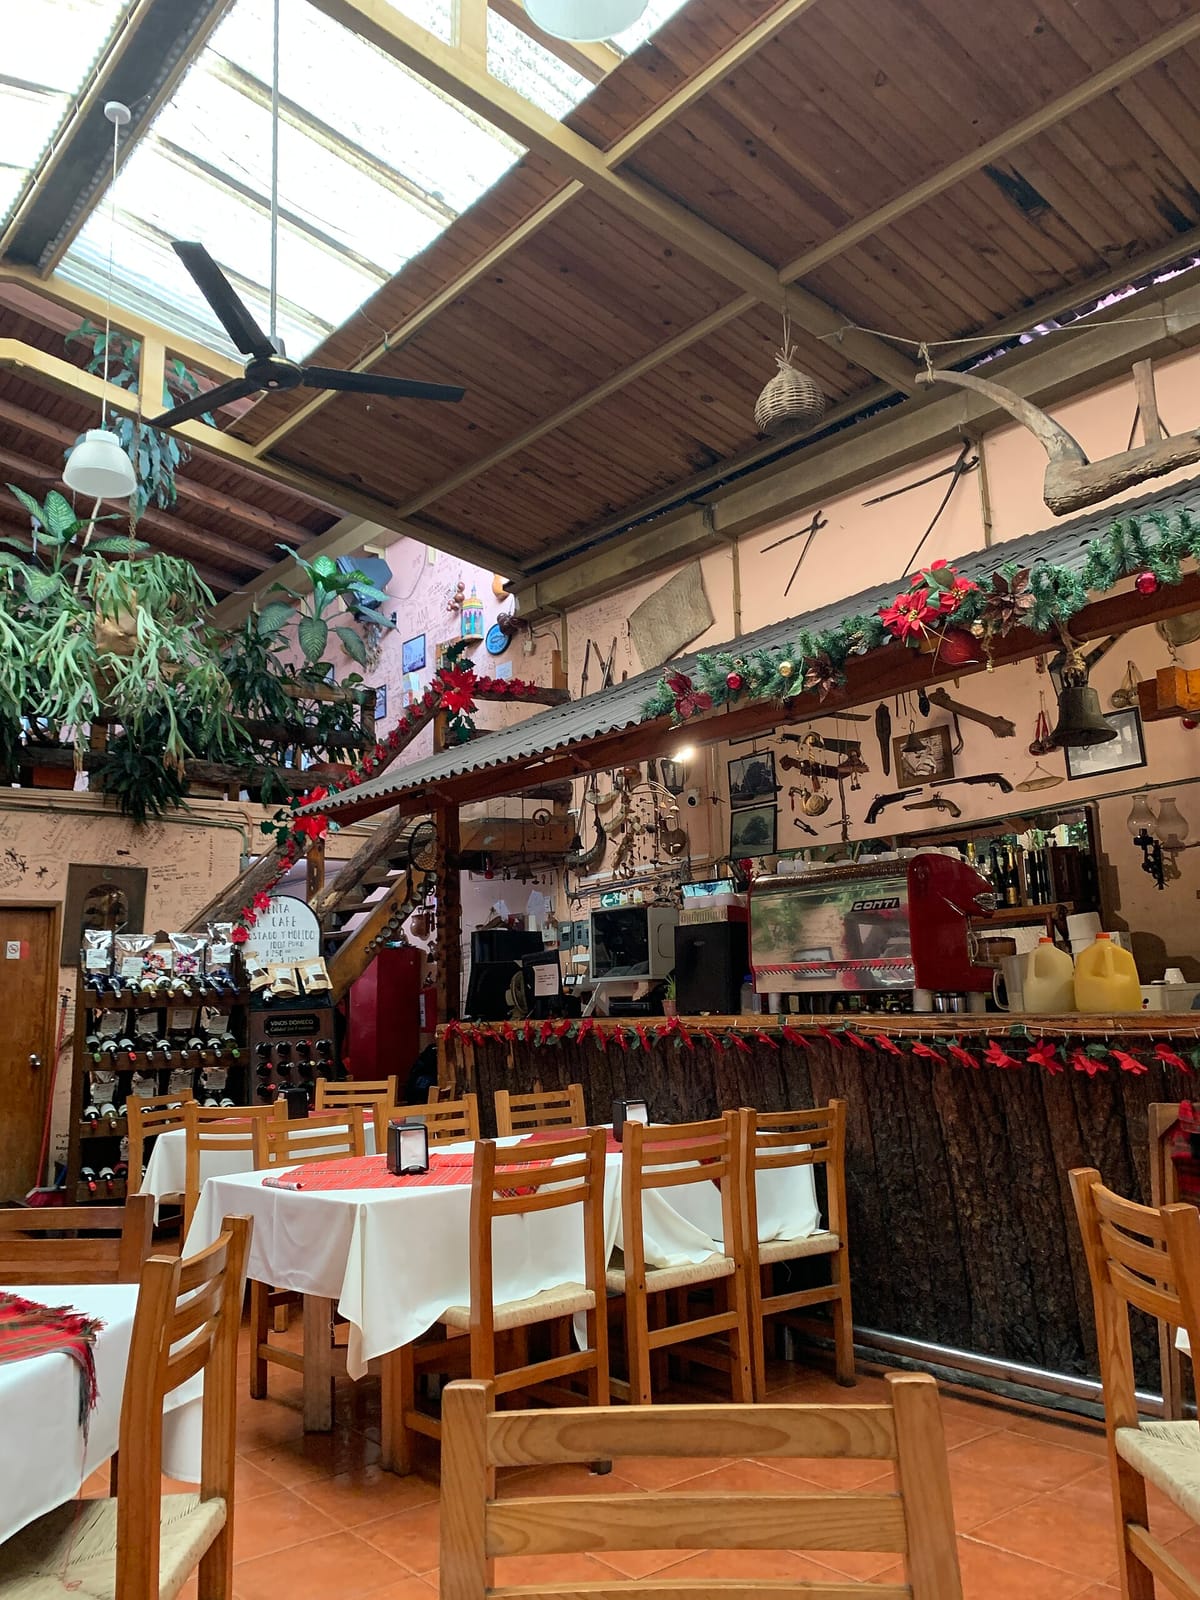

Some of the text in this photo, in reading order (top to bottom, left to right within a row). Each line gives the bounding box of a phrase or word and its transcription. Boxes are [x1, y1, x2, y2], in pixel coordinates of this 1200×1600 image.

[272, 916, 297, 927] CAFE
[248, 930, 278, 941] OSTADO
[287, 929, 315, 940] MOLIDO
